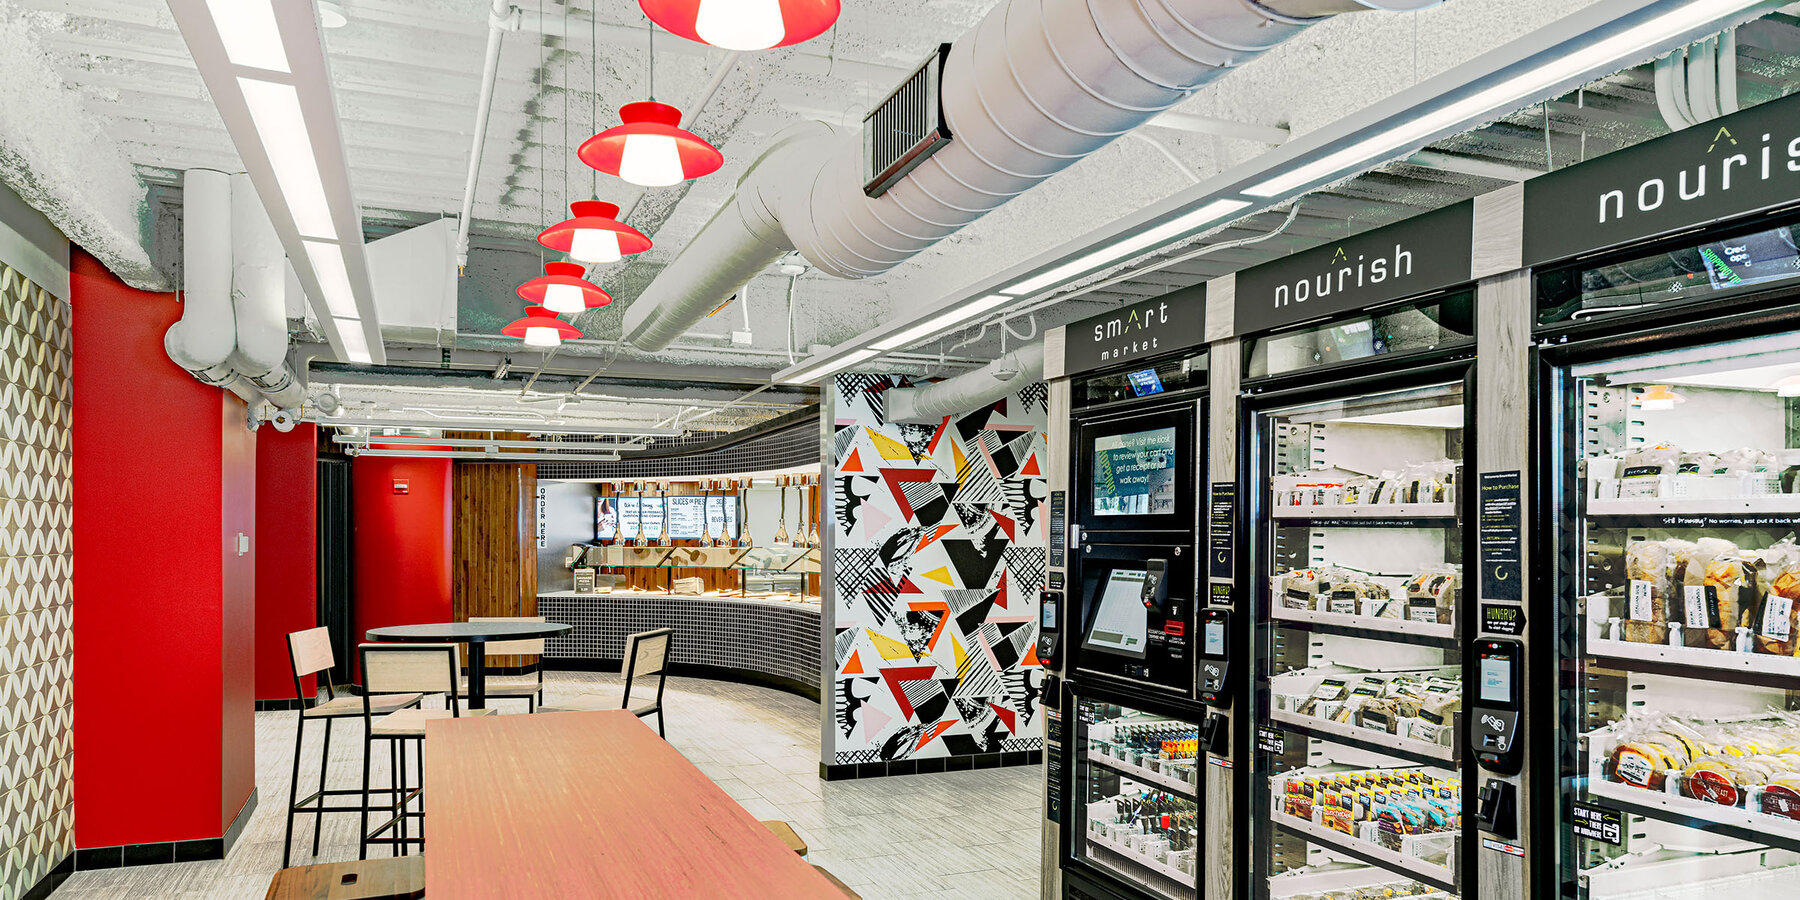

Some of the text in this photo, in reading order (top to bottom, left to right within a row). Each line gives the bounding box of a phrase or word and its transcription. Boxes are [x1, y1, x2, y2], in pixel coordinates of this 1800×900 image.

[1703, 248, 1742, 284] SHOPPING TIP
[1274, 244, 1412, 308] nourish
[1101, 337, 1158, 360] market
[1136, 437, 1146, 446] Visit
[1157, 434, 1170, 444] kiosk
[1113, 448, 1174, 461] to review your cart and
[1099, 449, 1116, 495] HOPPING
[1115, 464, 1125, 474] get
[1130, 462, 1150, 472] receipt
[1119, 476, 1132, 484] walk
[672, 497, 689, 505] SLICES
[1487, 607, 1516, 621] HUNGRY?
[1573, 807, 1589, 818] START
[1590, 811, 1602, 821] HERE
[1573, 825, 1602, 839] OR ANYWHERE
[1589, 820, 1602, 830] THERE
